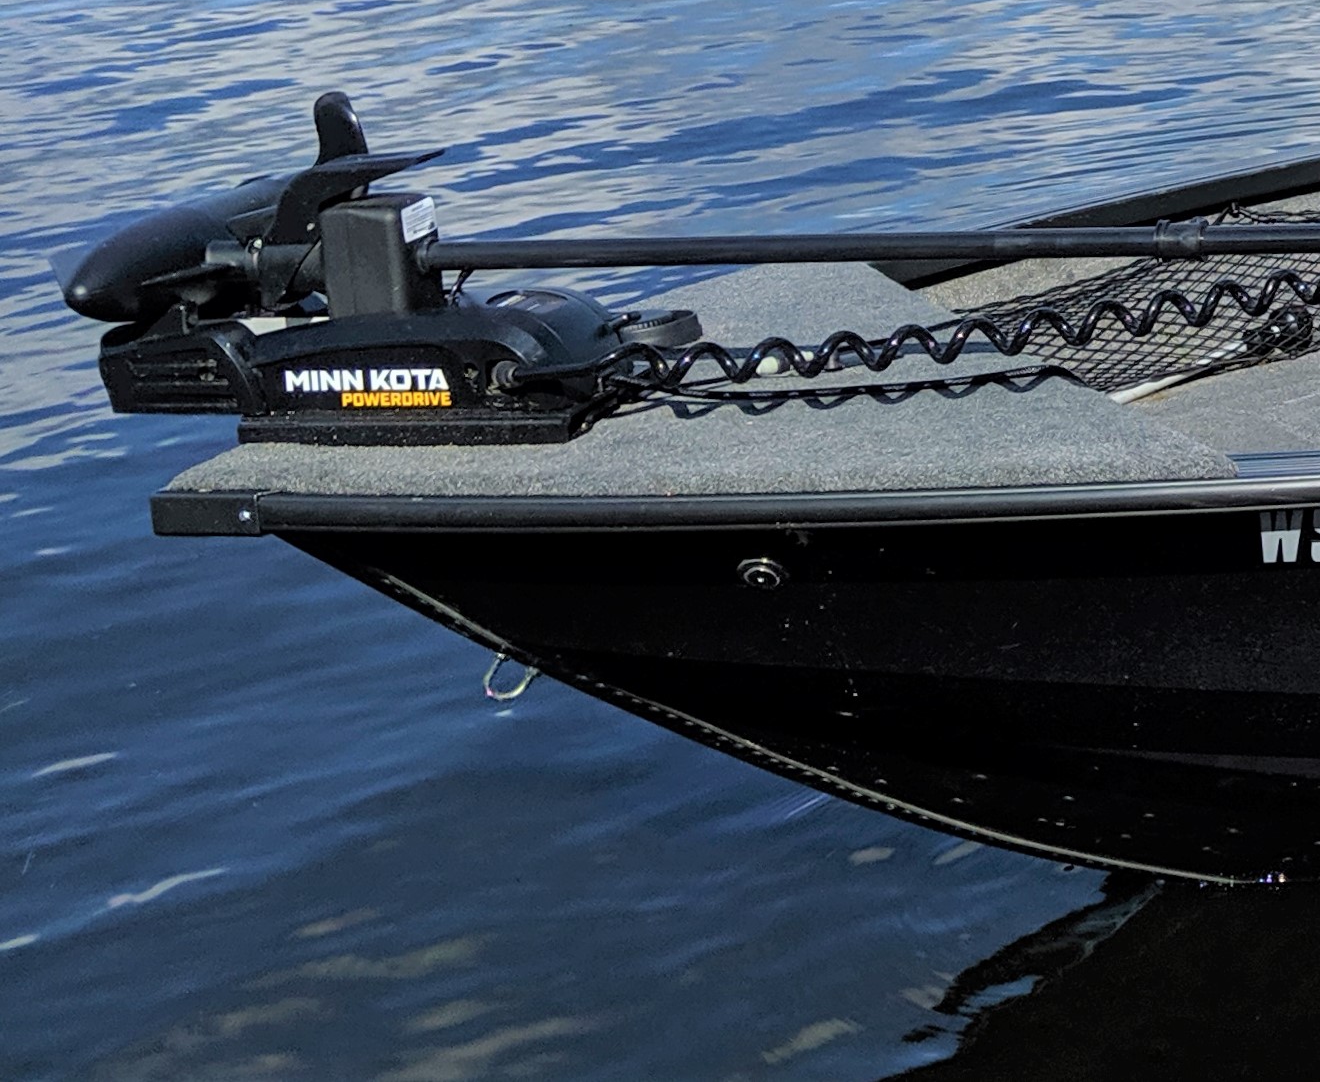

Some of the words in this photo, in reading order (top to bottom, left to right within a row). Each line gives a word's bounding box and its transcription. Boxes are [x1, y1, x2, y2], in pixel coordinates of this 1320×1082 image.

[284, 369, 364, 393] MINN
[369, 368, 450, 392] KOTA
[341, 391, 452, 408] POWERDRIVE
